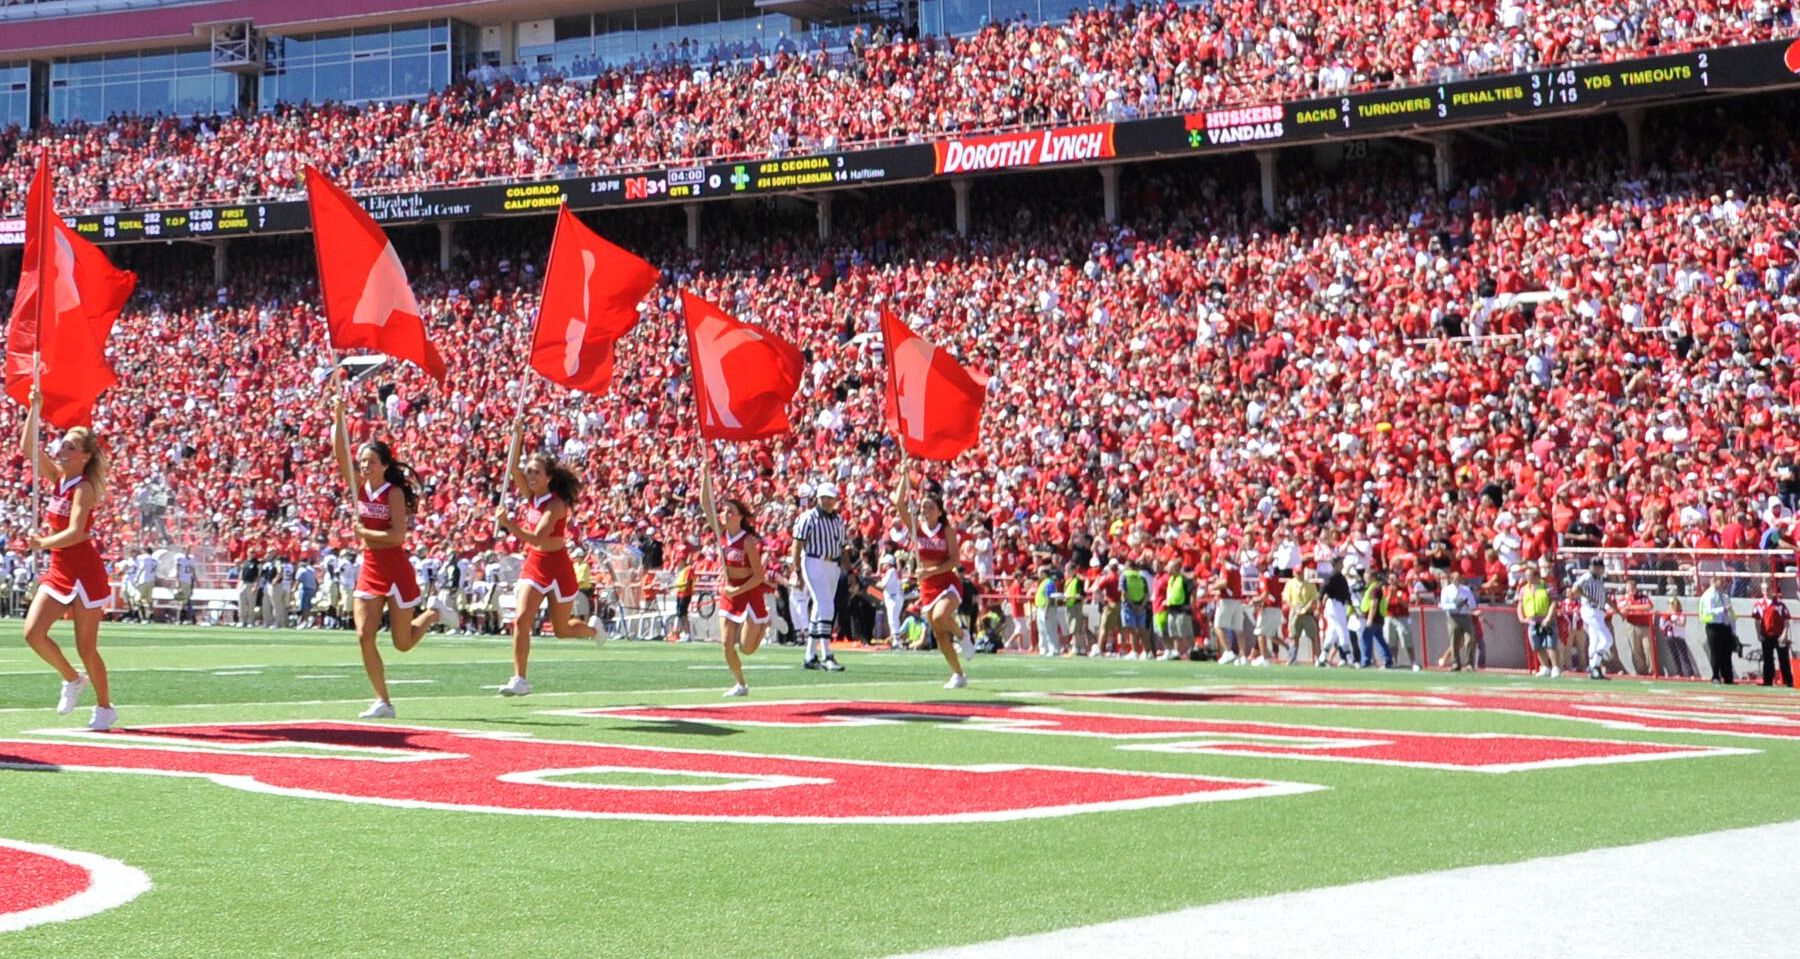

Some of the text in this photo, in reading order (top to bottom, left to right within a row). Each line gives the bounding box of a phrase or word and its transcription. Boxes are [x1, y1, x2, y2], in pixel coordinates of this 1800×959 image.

[1698, 53, 1708, 68] 2
[1531, 74, 1540, 89] 3
[1557, 70, 1576, 85] 45
[1584, 66, 1691, 90] YDS TIMEOUTS
[1700, 72, 1708, 86] 1
[1453, 86, 1523, 106] PENALTIES
[1533, 92, 1542, 106] 3
[1559, 88, 1578, 103] 15
[1341, 97, 1350, 112] 2
[1358, 97, 1432, 117] TURNOVERS
[1437, 103, 1447, 118] 3
[1205, 105, 1284, 129] HUSKERS
[1296, 108, 1337, 124] SACKS
[1342, 115, 1350, 129] 1
[1208, 122, 1284, 144] VANDALS
[944, 131, 1103, 173] DOROTHY LYNCH
[781, 157, 830, 171] GEORGIA
[709, 174, 722, 189] 0
[771, 174, 796, 187] SOUTH
[796, 171, 833, 185] CAROLINA
[835, 170, 847, 182] 14
[850, 168, 885, 180] Halftime
[506, 184, 560, 198] COLORADO
[647, 179, 666, 194] 31
[669, 184, 700, 197] QTR 2
[504, 197, 562, 210] CALIFORNIA
[221, 209, 245, 219] FIRST
[77, 222, 99, 232] PASS
[118, 220, 144, 230] TOTAL
[218, 218, 248, 229] DOWNS
